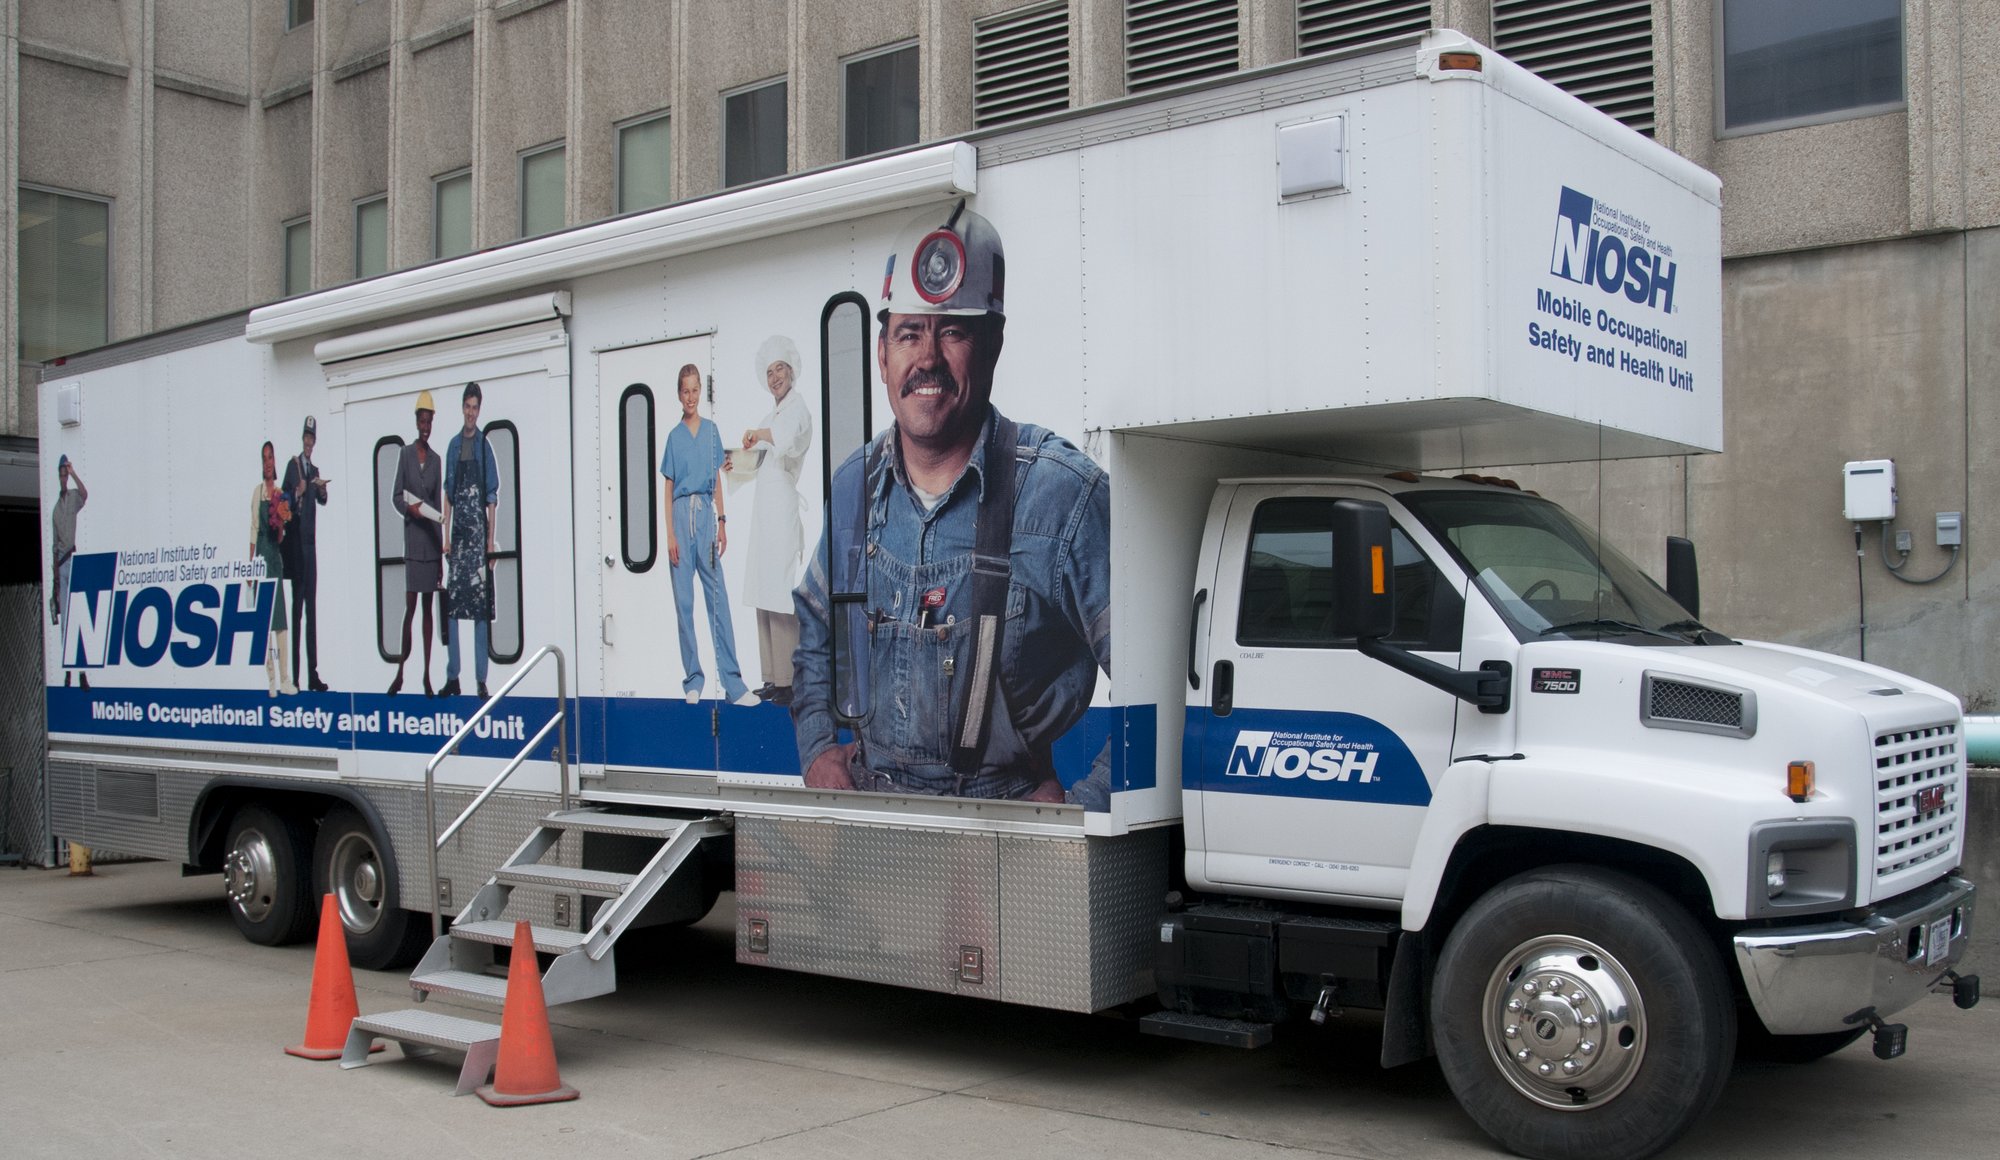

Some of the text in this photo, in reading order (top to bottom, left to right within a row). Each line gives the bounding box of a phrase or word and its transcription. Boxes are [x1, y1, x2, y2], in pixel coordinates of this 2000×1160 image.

[1594, 199, 1651, 234] National Institute for
[1592, 212, 1673, 257] Occupational Safety and Health
[1551, 214, 1677, 314] NIOSH
[1537, 288, 1687, 359] Mobile Occupational
[1528, 322, 1693, 392] Safety and Health Unit
[119, 543, 217, 566] National Institute for
[117, 560, 266, 587] Occupational Safety and Health
[62, 580, 276, 668] NIOSH
[1535, 680, 1577, 691] C7500
[1540, 670, 1572, 679] GMC
[92, 701, 525, 740] Mobile Occupational Safety and Health Unit
[1273, 731, 1343, 742] National Institute for
[1271, 738, 1374, 751] Occupational Safety and Health
[1226, 745, 1379, 783] NIOSH
[1919, 785, 1946, 813] GMC
